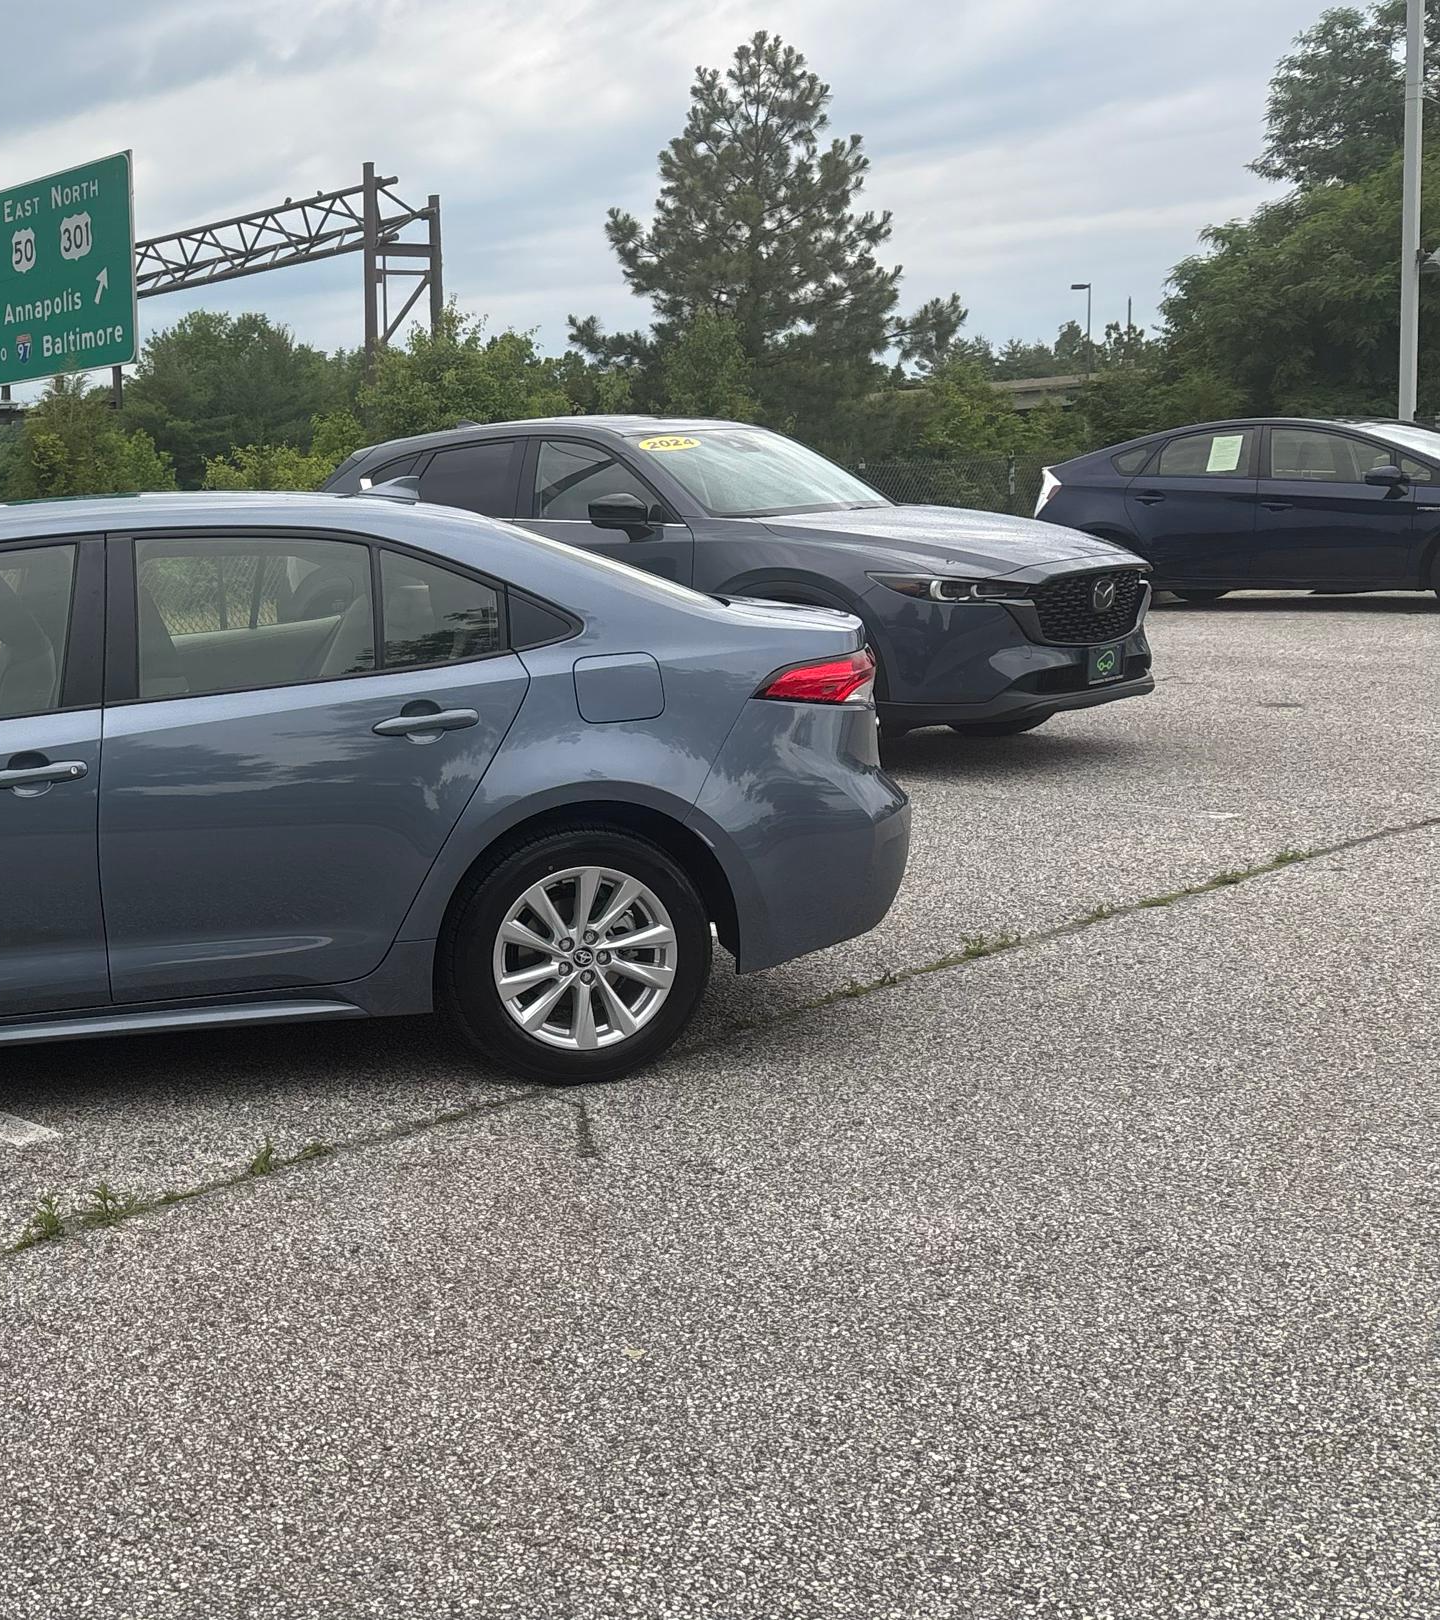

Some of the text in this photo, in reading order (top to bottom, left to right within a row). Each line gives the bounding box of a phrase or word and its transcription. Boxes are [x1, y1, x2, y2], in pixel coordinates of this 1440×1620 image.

[4, 179, 99, 222] EAST NORTH
[14, 221, 91, 265] 50 301
[4, 288, 82, 325] Annapolis
[17, 342, 31, 360] 97
[43, 325, 123, 357] Baltimore
[646, 438, 695, 450] 2024
